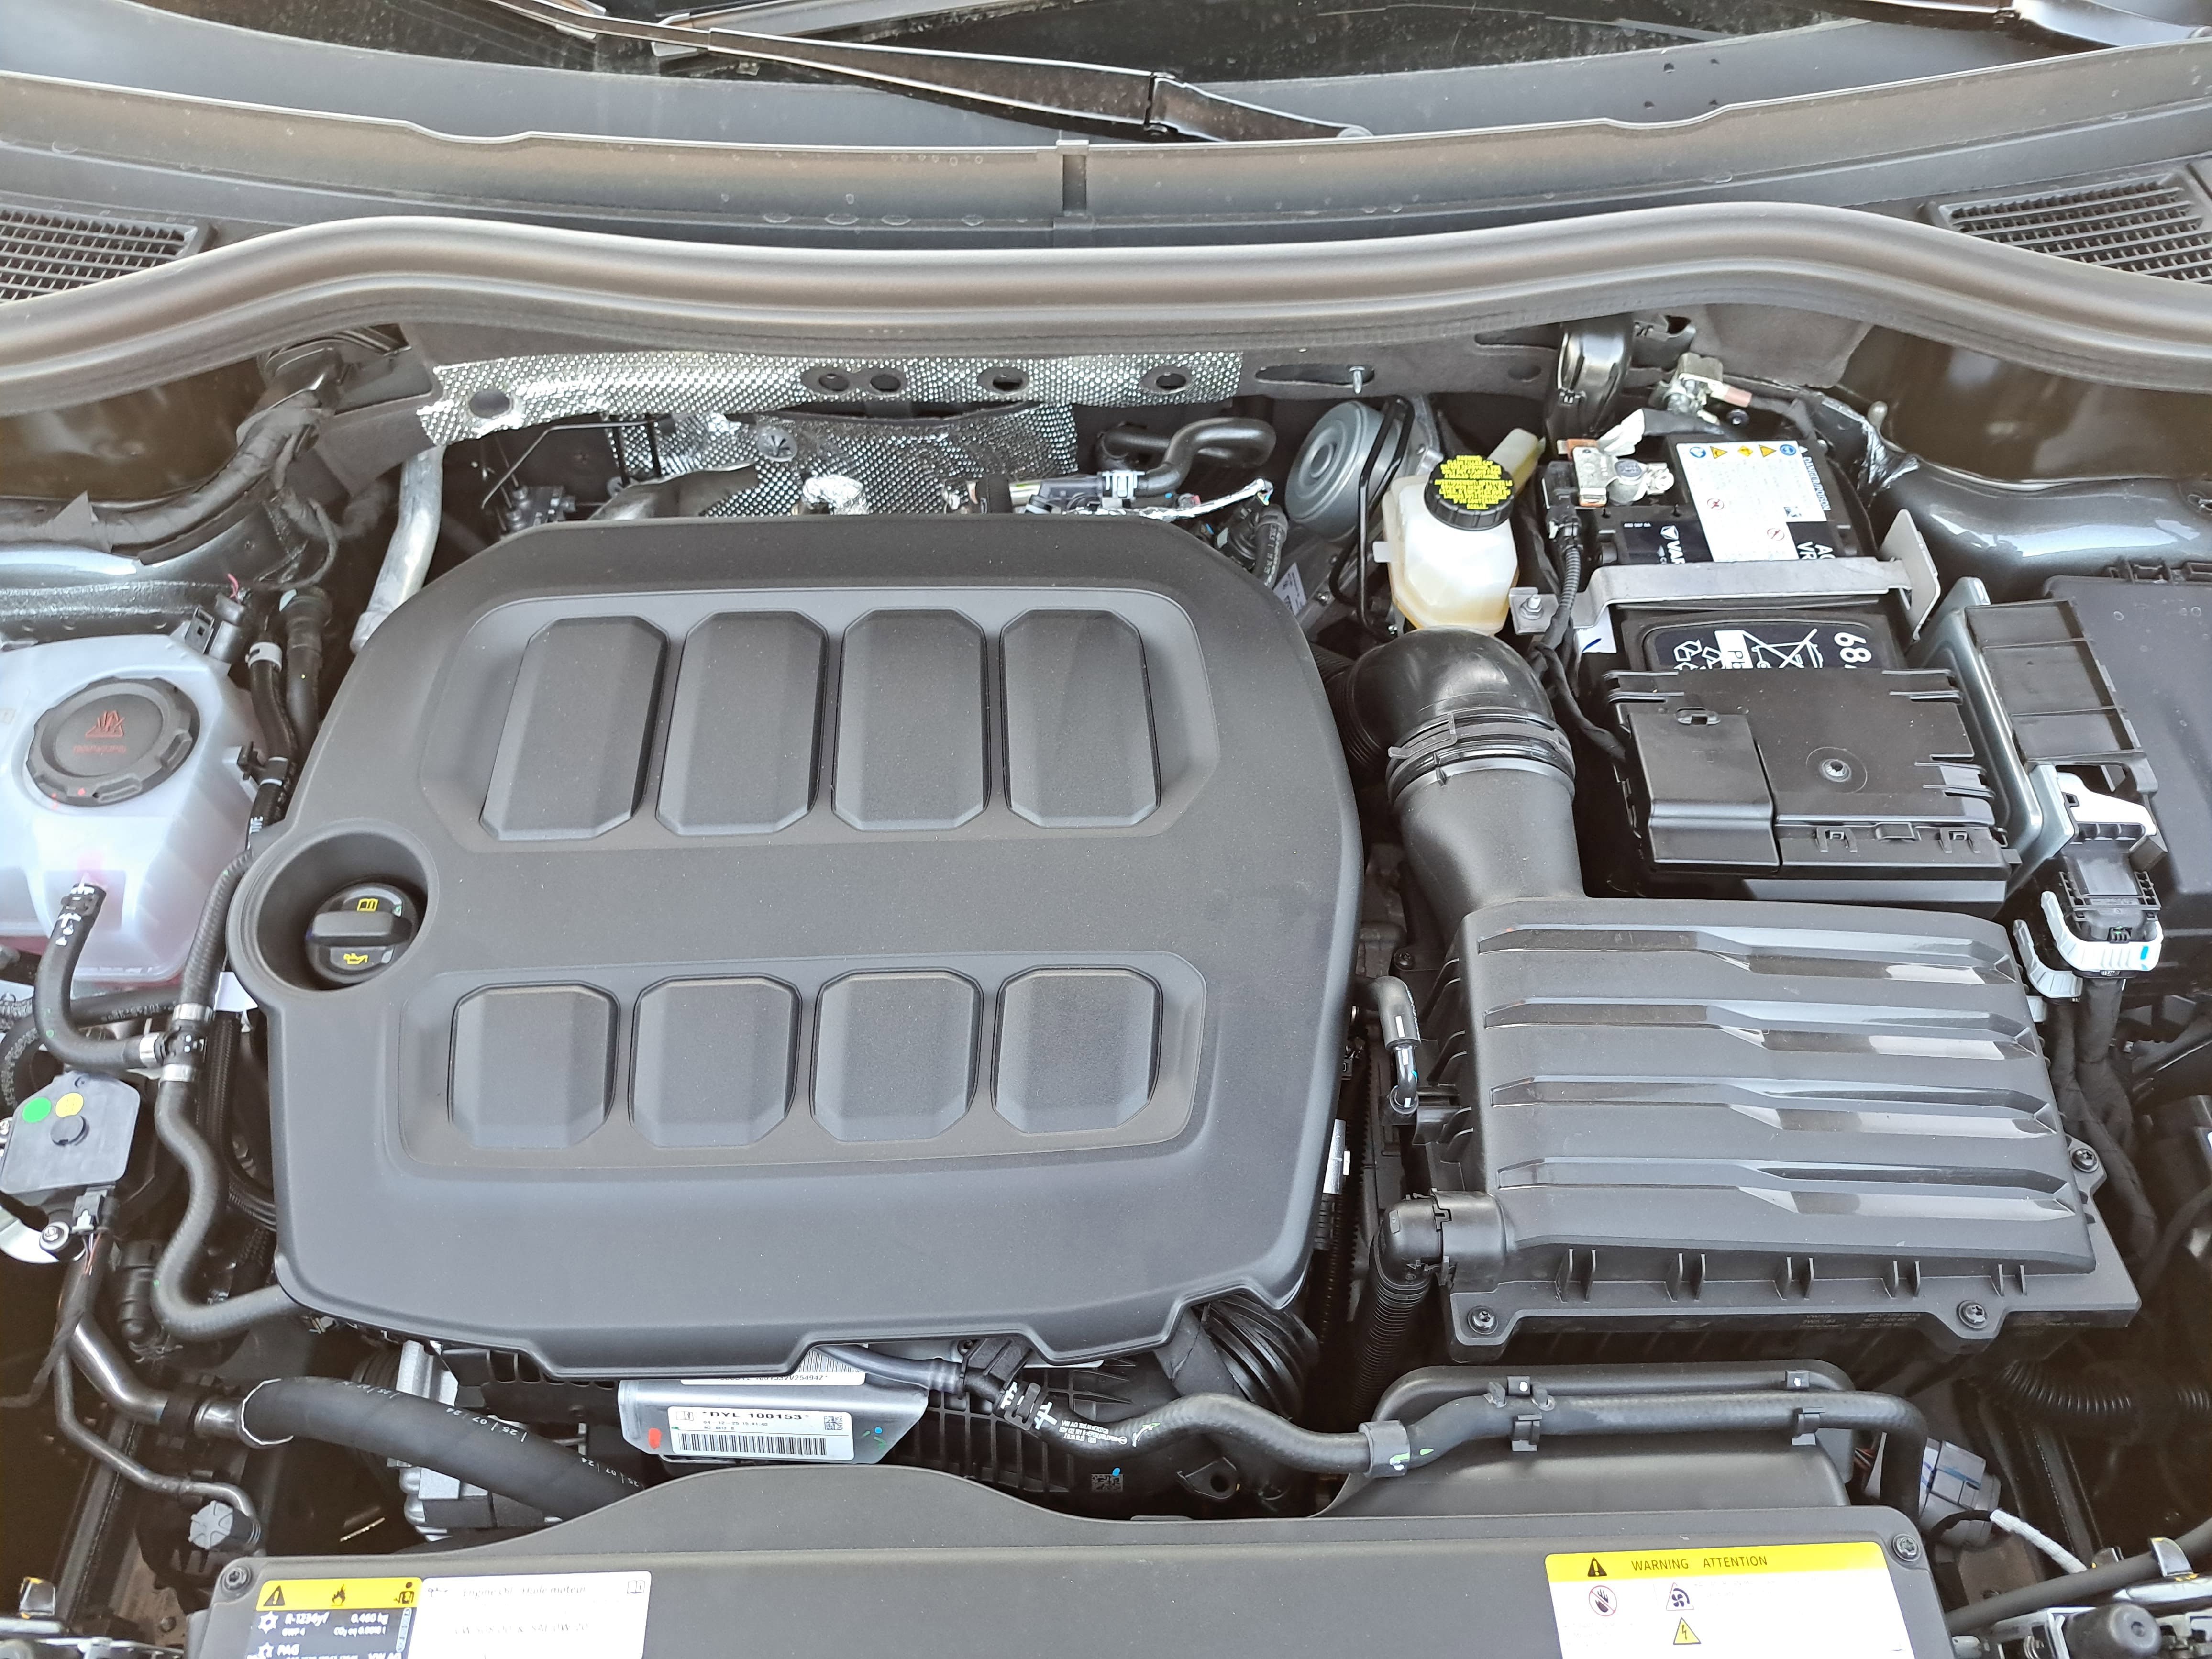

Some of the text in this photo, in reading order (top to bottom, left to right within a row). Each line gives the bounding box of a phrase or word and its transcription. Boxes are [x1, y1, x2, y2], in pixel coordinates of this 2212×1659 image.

[1631, 1556, 1767, 1571] WARNING ATTENTION
[551, 1585, 586, 1594] moteur
